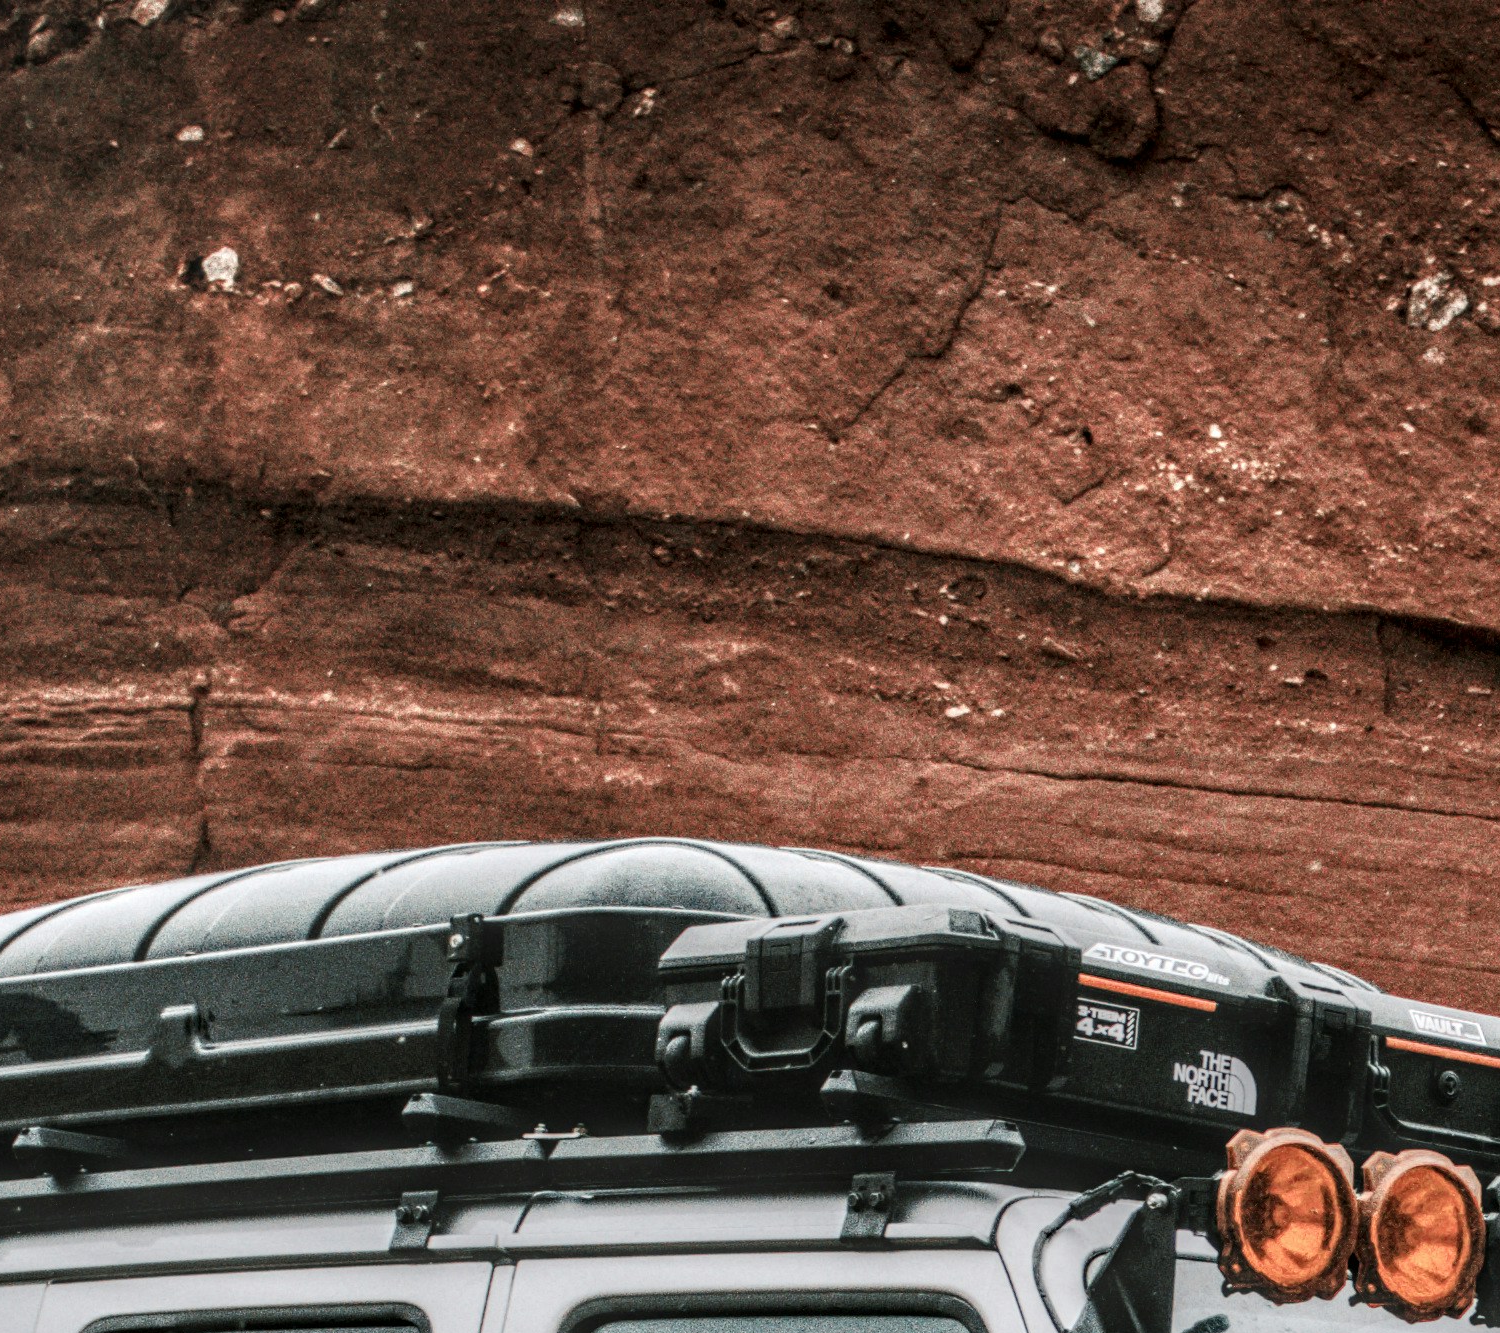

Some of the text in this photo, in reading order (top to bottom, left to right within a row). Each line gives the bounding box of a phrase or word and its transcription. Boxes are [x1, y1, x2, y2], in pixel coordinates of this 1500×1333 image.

[1101, 946, 1208, 979] TOYTEC
[1076, 1017, 1125, 1042] 4x4
[1414, 1013, 1463, 1037] VAULT
[1200, 1050, 1233, 1073] THE
[1173, 1062, 1230, 1092] NORTH
[1187, 1085, 1229, 1109] FACE
